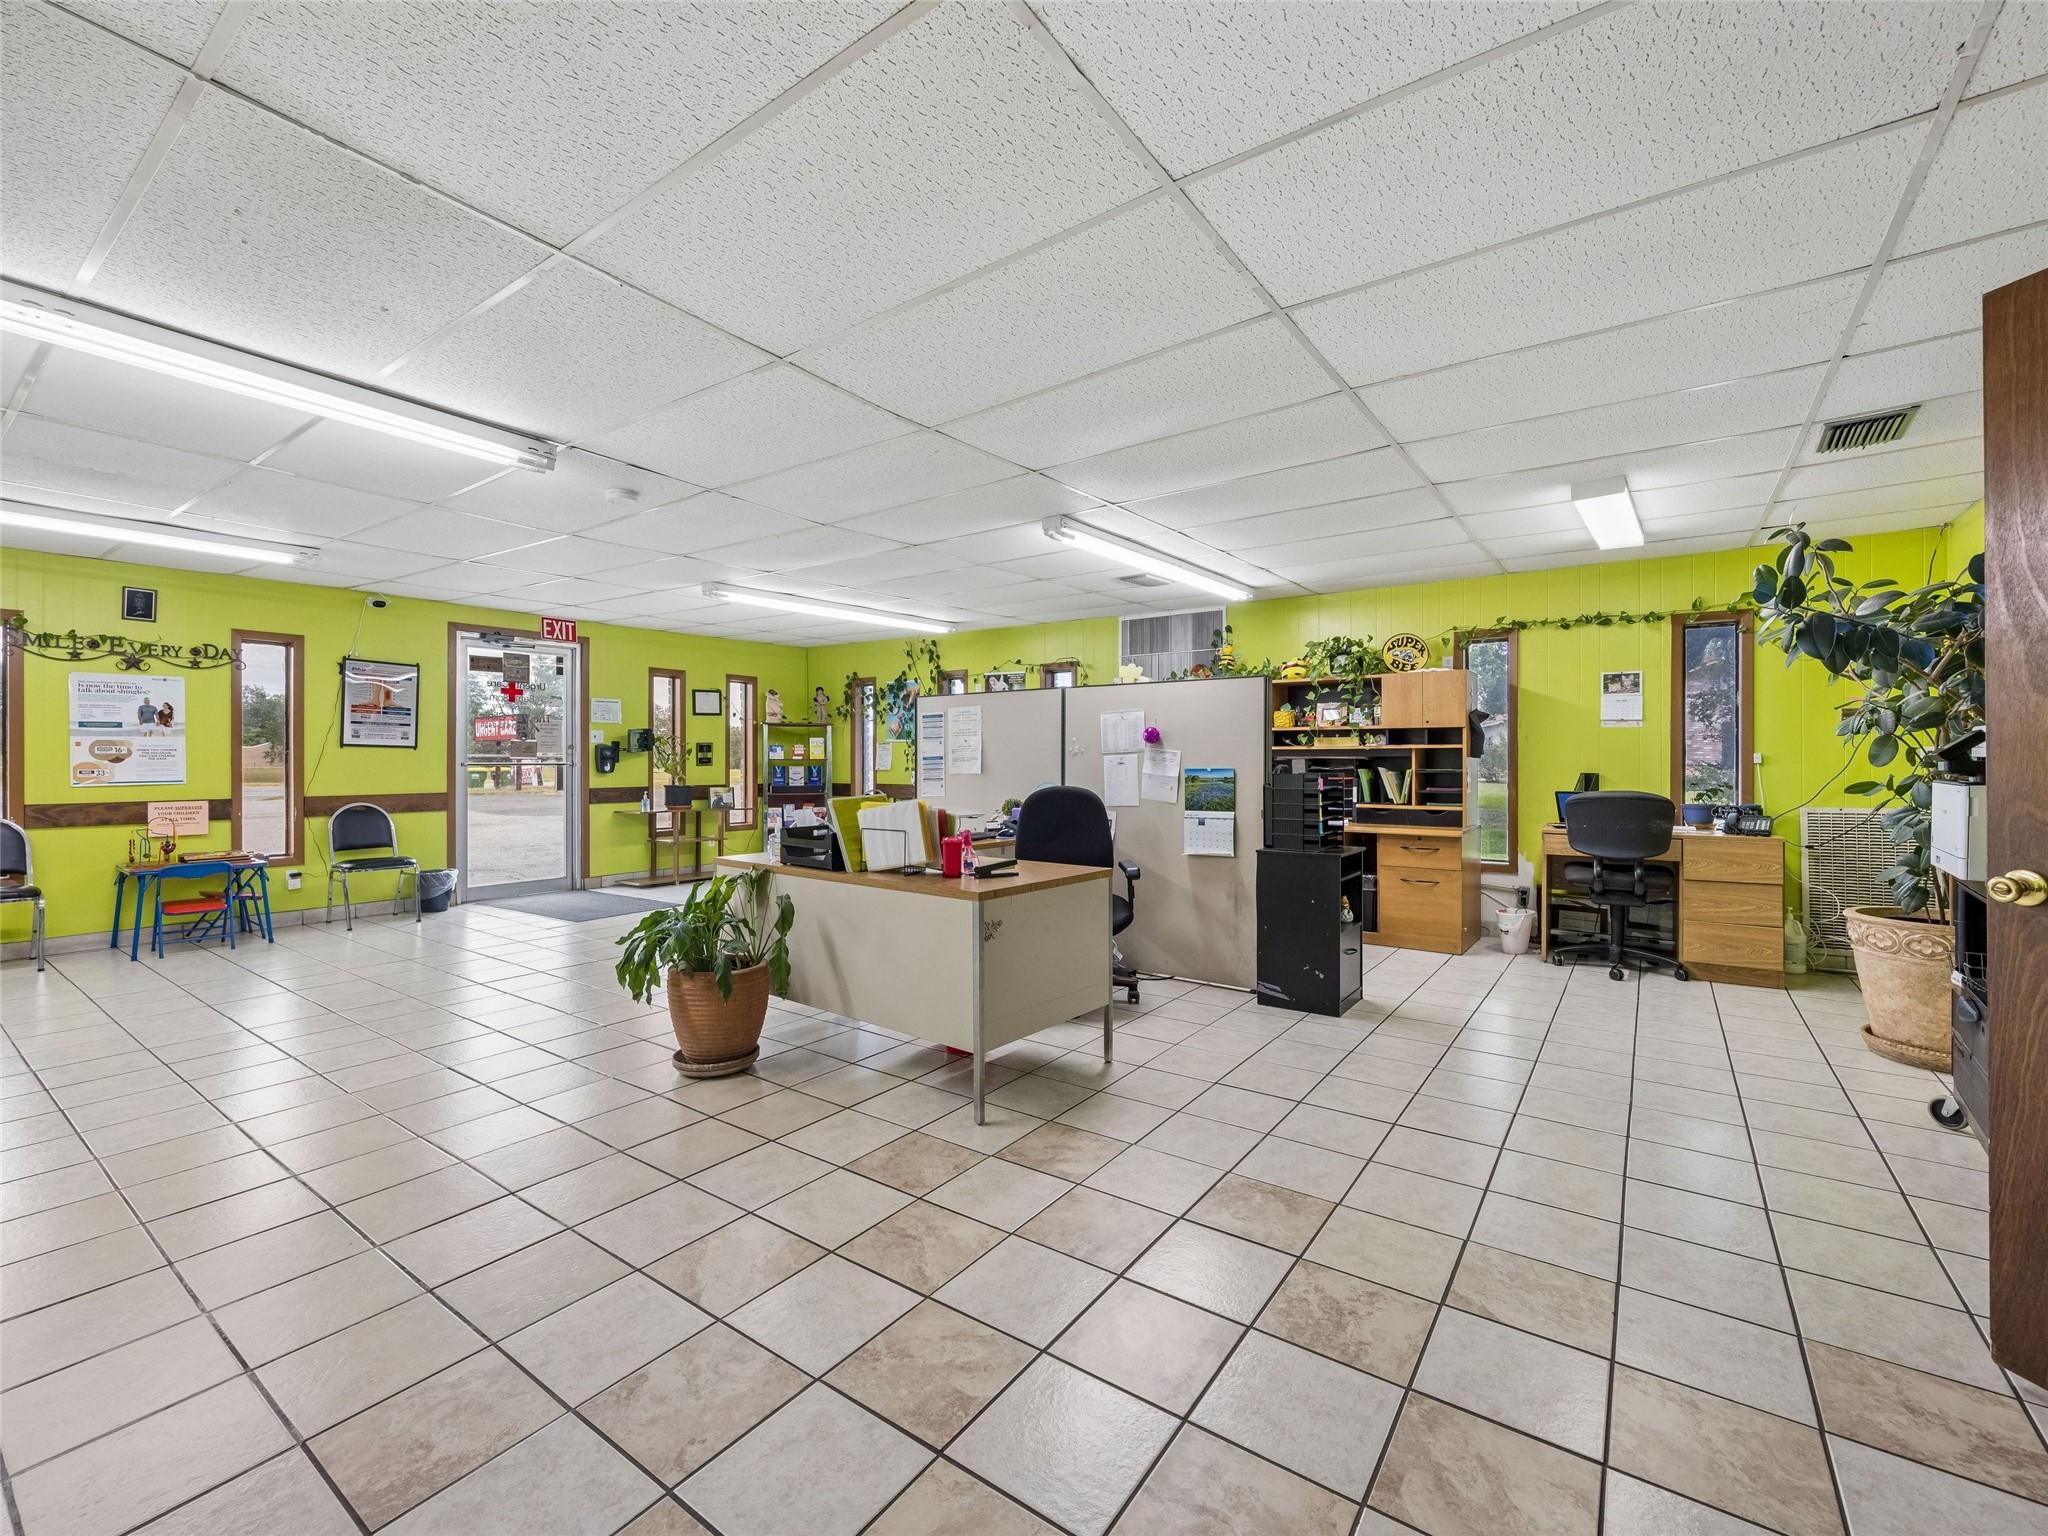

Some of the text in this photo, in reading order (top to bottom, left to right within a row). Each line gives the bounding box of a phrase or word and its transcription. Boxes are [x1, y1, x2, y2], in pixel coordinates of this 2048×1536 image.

[543, 619, 575, 641] EXIT
[109, 635, 183, 658] EVERY
[202, 644, 243, 660] DAY
[1387, 636, 1426, 657] SUPER
[1390, 658, 1419, 671] BEE
[475, 721, 499, 737] URGENT
